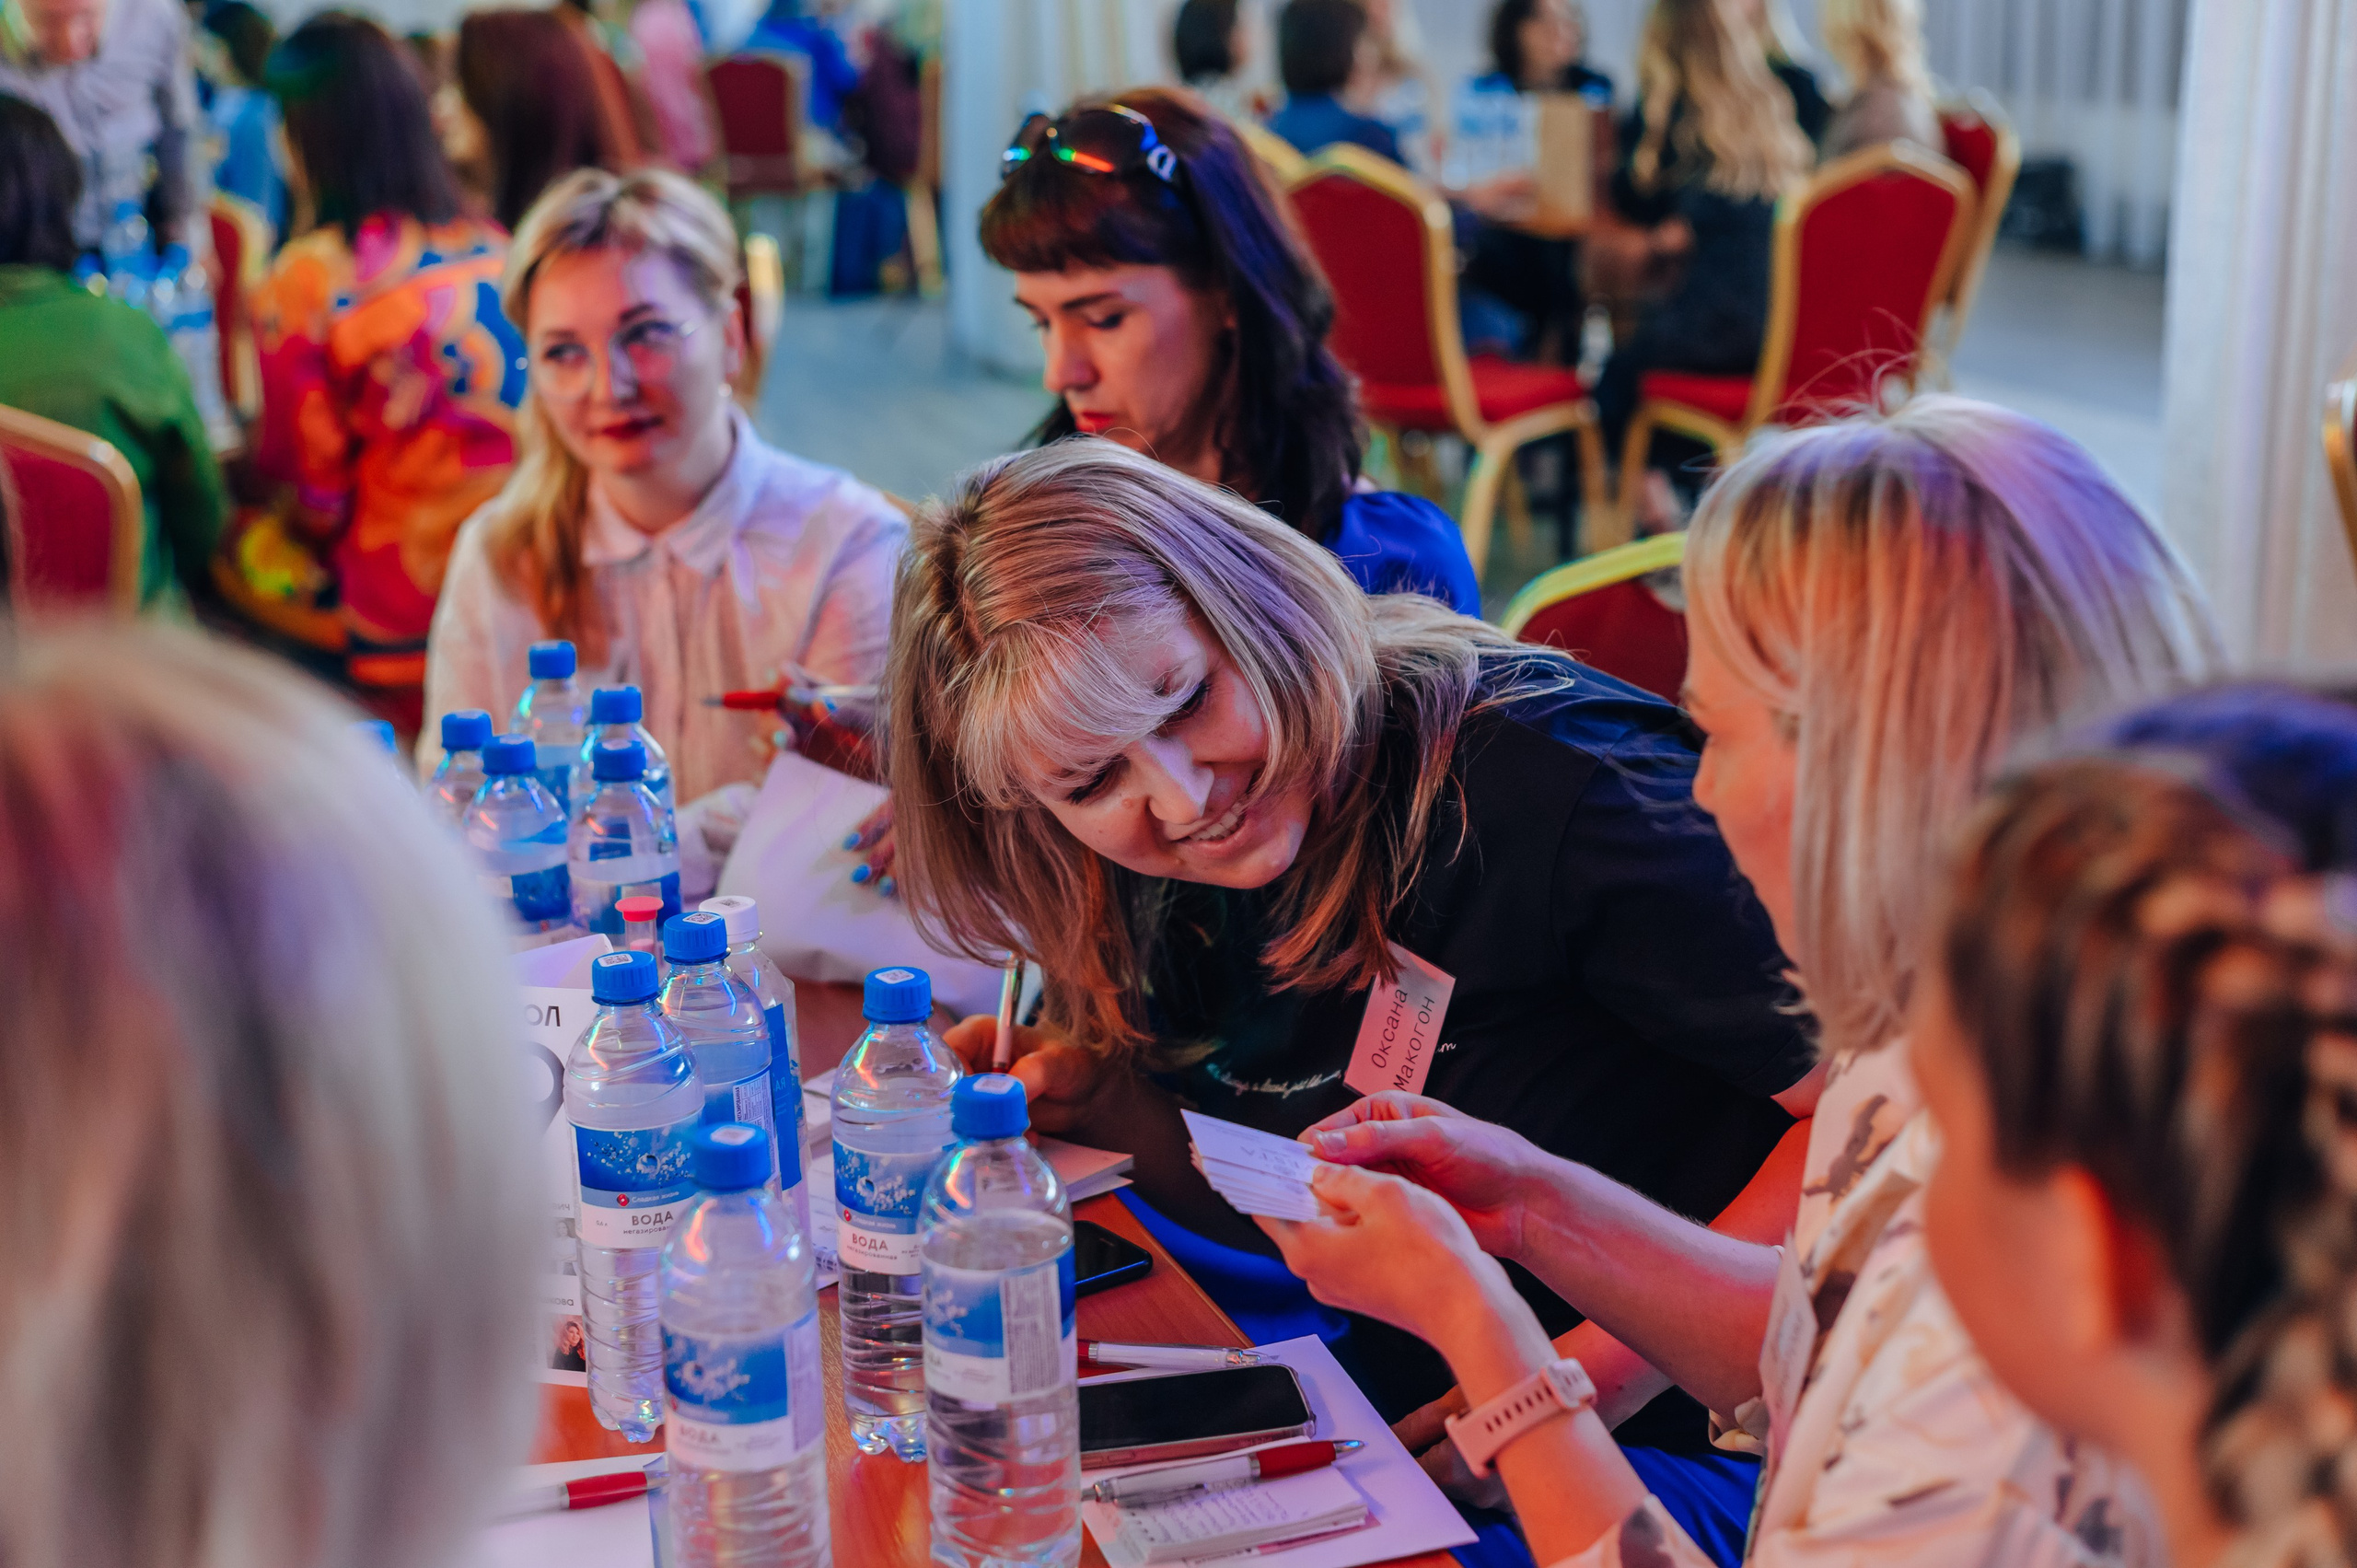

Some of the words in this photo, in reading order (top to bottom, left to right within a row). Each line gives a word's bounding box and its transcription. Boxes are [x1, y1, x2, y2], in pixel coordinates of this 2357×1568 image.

[525, 1004, 561, 1027] ОЛ
[1371, 989, 1408, 1068] Оксана
[1393, 996, 1435, 1092] Макогон
[632, 1211, 673, 1226] ВОДА
[623, 1225, 671, 1235] негазирован
[853, 1233, 888, 1251] ВОДА
